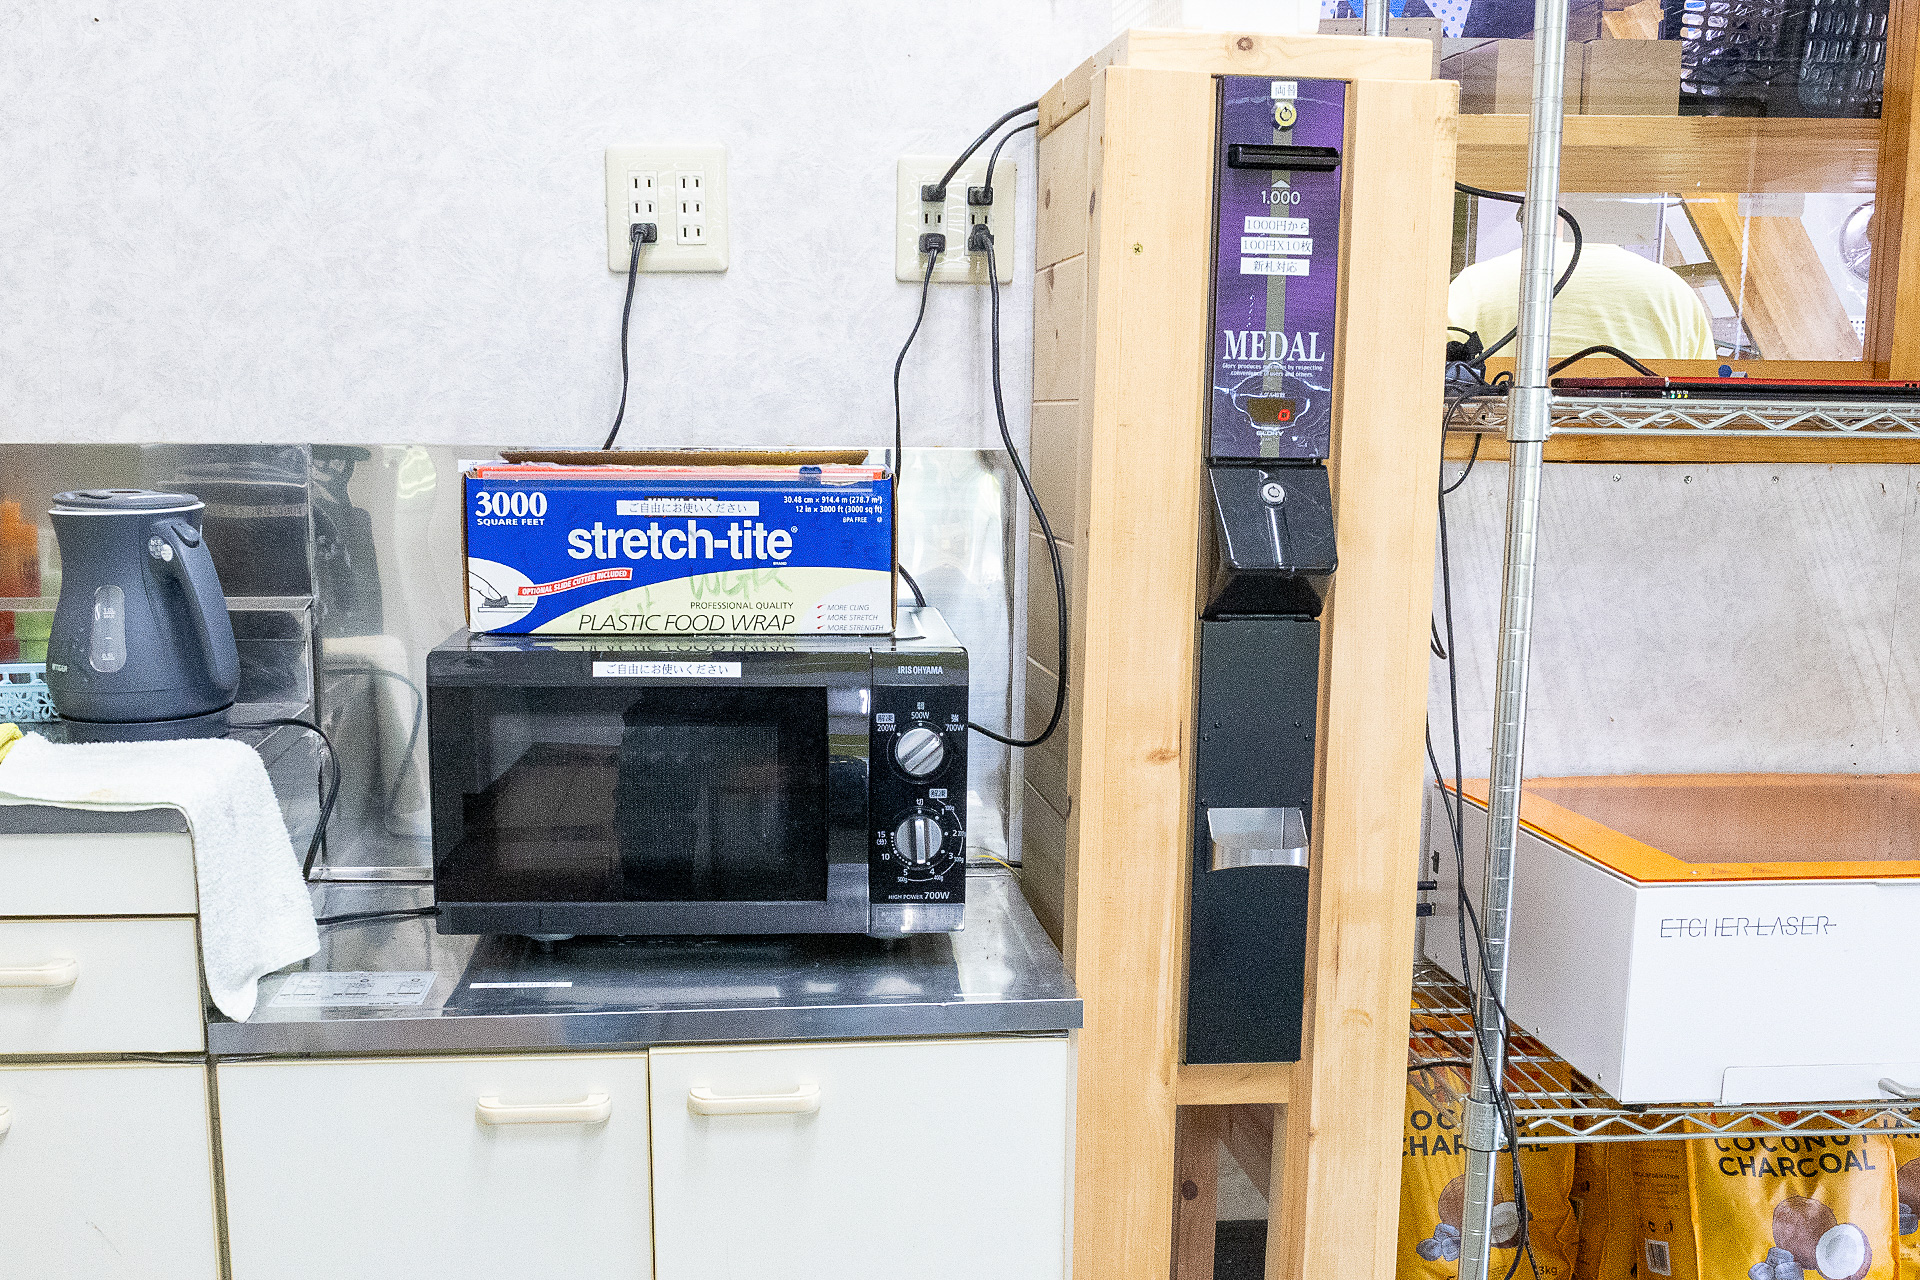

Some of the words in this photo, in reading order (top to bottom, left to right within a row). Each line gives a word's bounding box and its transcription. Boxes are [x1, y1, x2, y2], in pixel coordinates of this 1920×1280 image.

[1247, 219, 1309, 233] 1000円から
[1253, 260, 1298, 273] 新札対応
[1222, 330, 1326, 362] MEDAL
[1277, 408, 1291, 422] 0
[475, 491, 548, 517] 3000
[783, 495, 802, 504] 30.48
[821, 495, 840, 504] 914.4
[849, 495, 870, 505] (278.7
[629, 502, 747, 514] ご自由にお使いください
[795, 505, 804, 513] 12
[805, 505, 812, 513] in
[819, 505, 836, 513] 3000
[837, 504, 844, 513] ft
[844, 505, 864, 514] (3000
[864, 506, 873, 515] sq
[874, 505, 883, 514] ft)
[476, 518, 519, 527] SQUARE
[521, 518, 545, 526] FEET
[567, 520, 793, 560] stretch-tite
[521, 585, 553, 595] OPTIONAL
[553, 581, 572, 591] SLIDE
[572, 574, 596, 586] CUTTER
[596, 570, 627, 580] INCLUDED
[690, 601, 753, 610] PROFESSIONAL
[755, 601, 794, 610] QUALITY
[578, 614, 661, 631] PLASTIC
[664, 614, 725, 631] FOOD
[731, 614, 795, 631] WRAP
[606, 663, 729, 675] ご自由にお使いください
[897, 665, 912, 675] IRIS
[913, 665, 943, 675] OHYAMA
[911, 711, 930, 720] 500W
[877, 723, 896, 732] 200W
[945, 723, 965, 732] 700W
[924, 891, 950, 900] 700W
[1718, 1149, 1876, 1178] CHARCOAL
